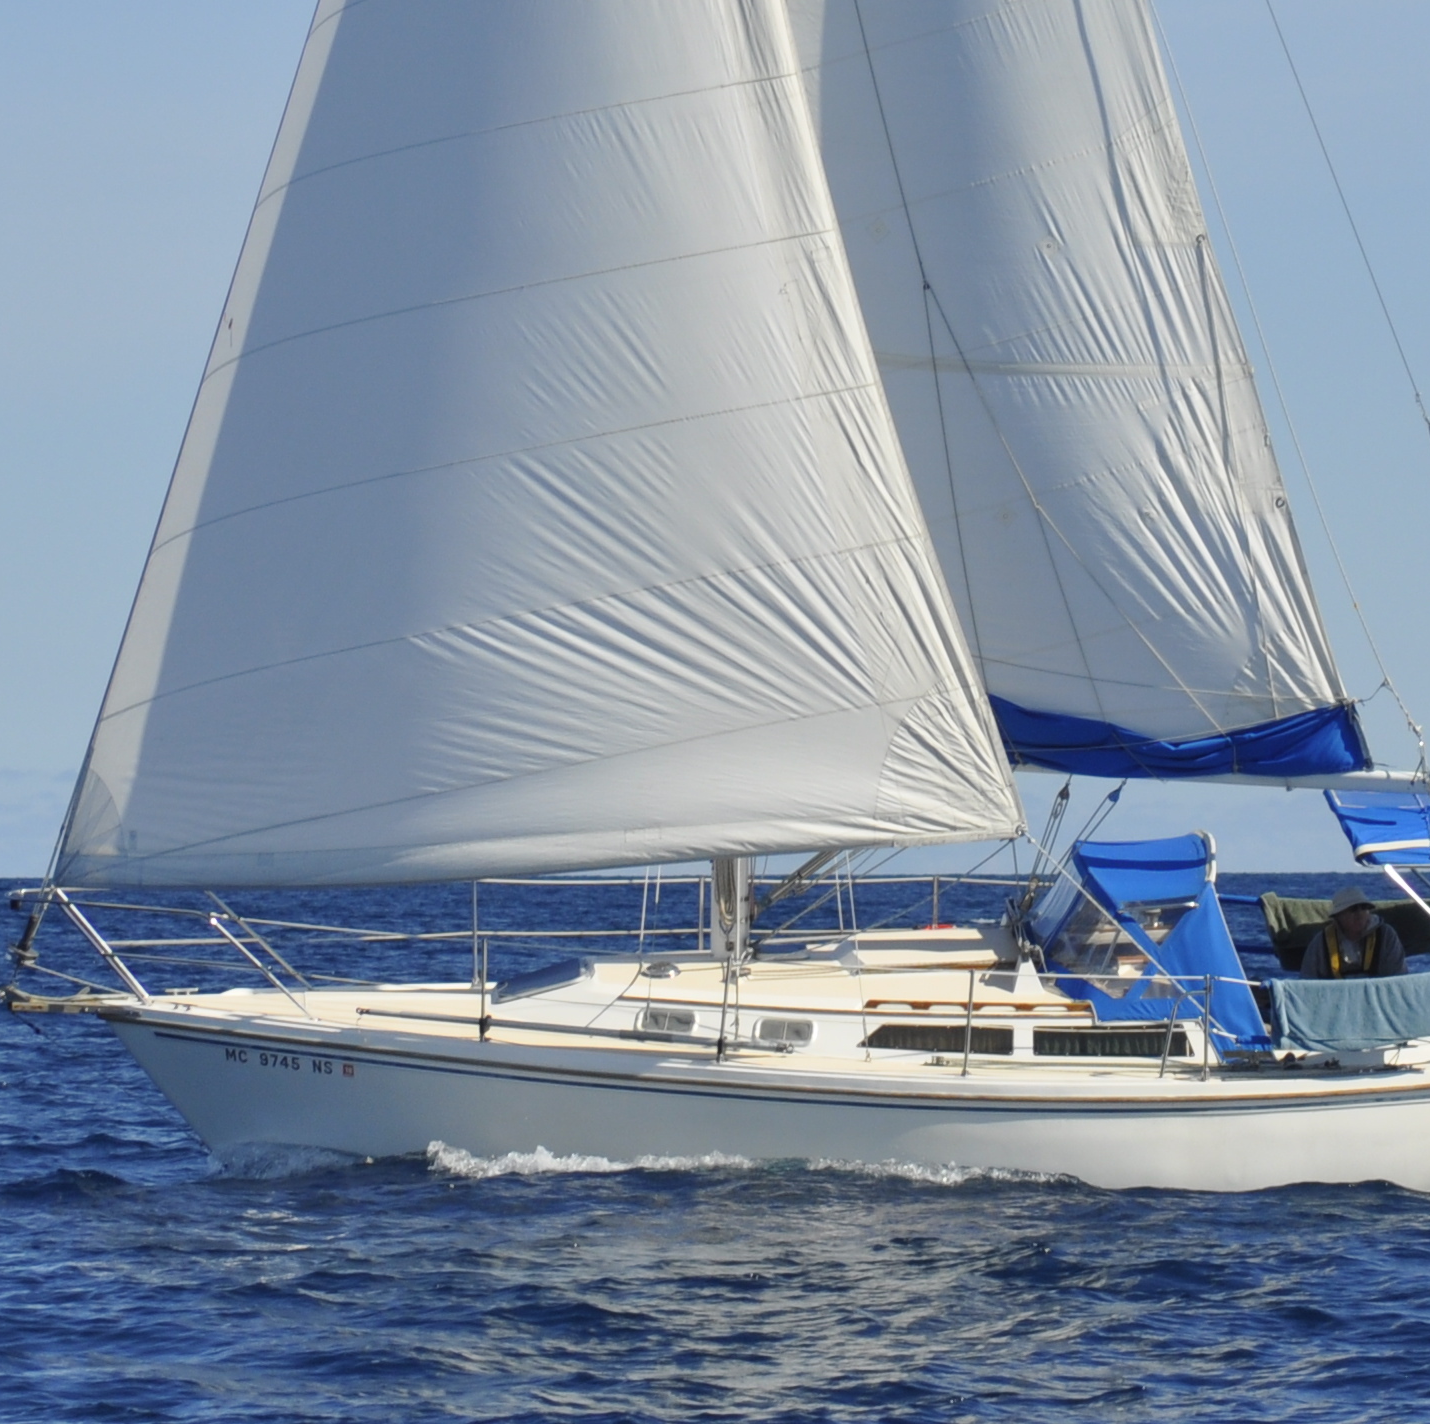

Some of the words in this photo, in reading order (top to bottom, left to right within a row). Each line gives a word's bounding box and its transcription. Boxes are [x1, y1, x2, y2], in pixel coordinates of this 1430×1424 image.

[224, 1047, 248, 1064] MC
[259, 1052, 301, 1071] 9745
[312, 1059, 334, 1075] NS
